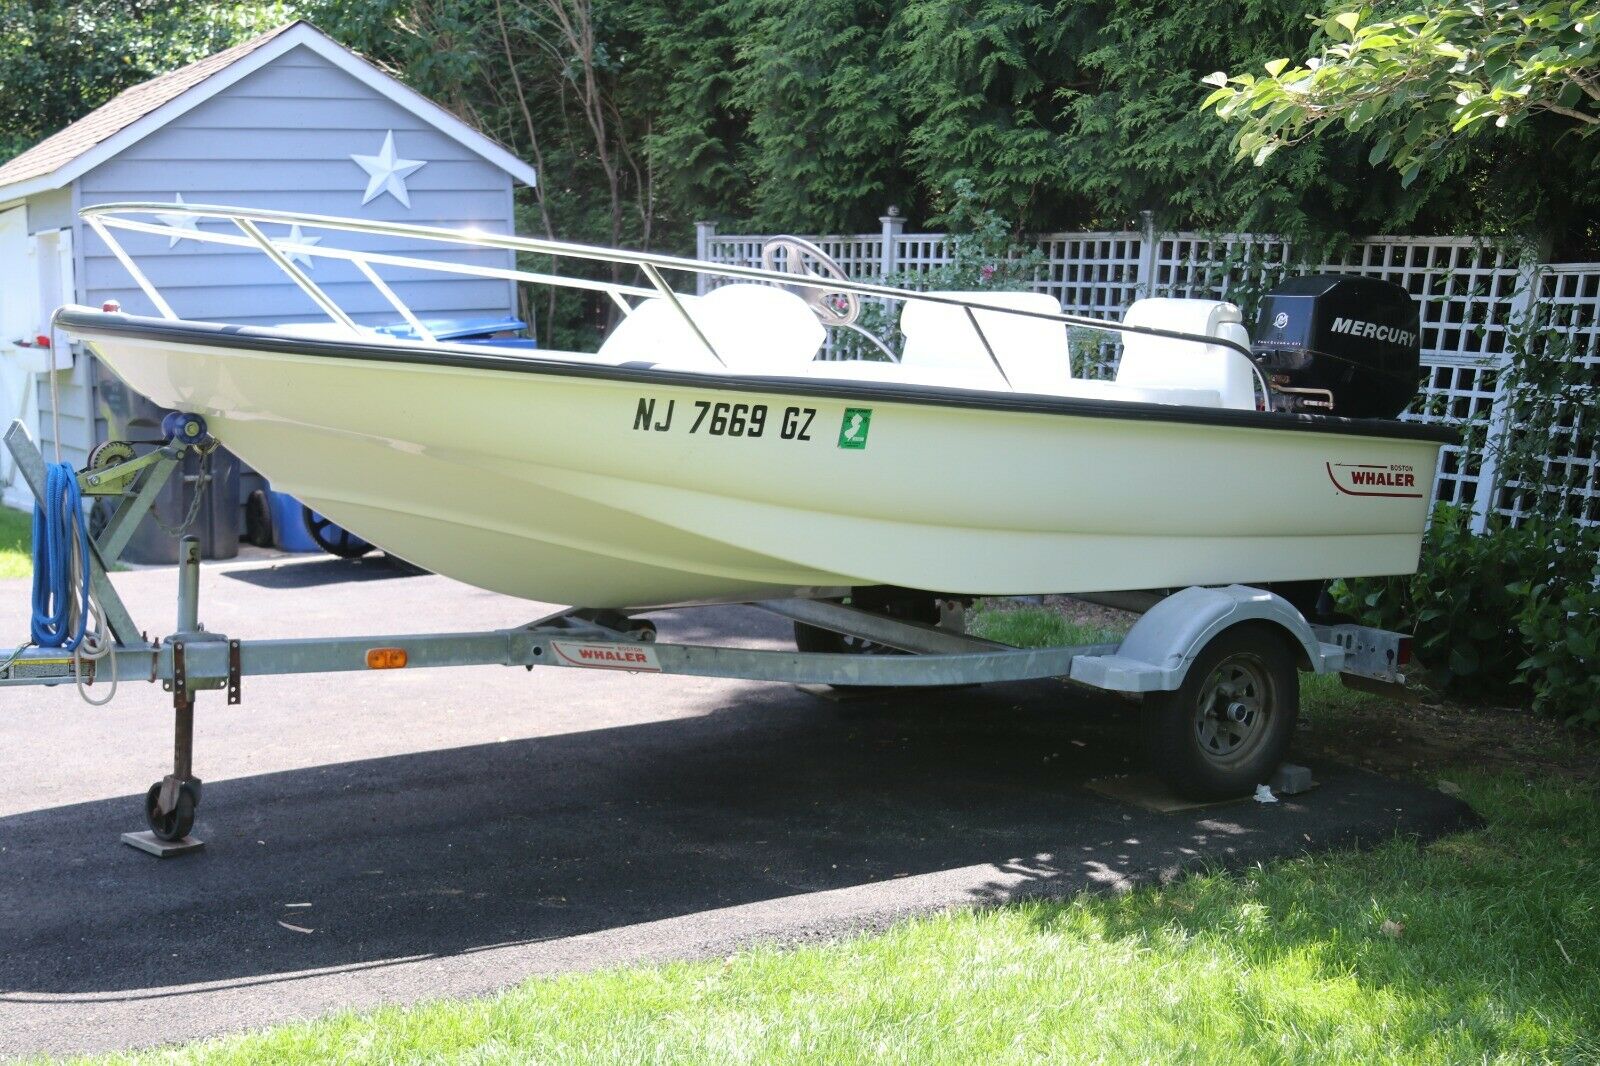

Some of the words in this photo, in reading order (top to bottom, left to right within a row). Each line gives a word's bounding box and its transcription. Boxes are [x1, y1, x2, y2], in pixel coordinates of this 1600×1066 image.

[1331, 317, 1416, 348] MERCURY
[633, 398, 675, 432] NJ
[689, 401, 768, 437] 7669
[780, 406, 817, 441] GZ
[1351, 472, 1414, 486] WHALER
[579, 649, 647, 662] WHALER
